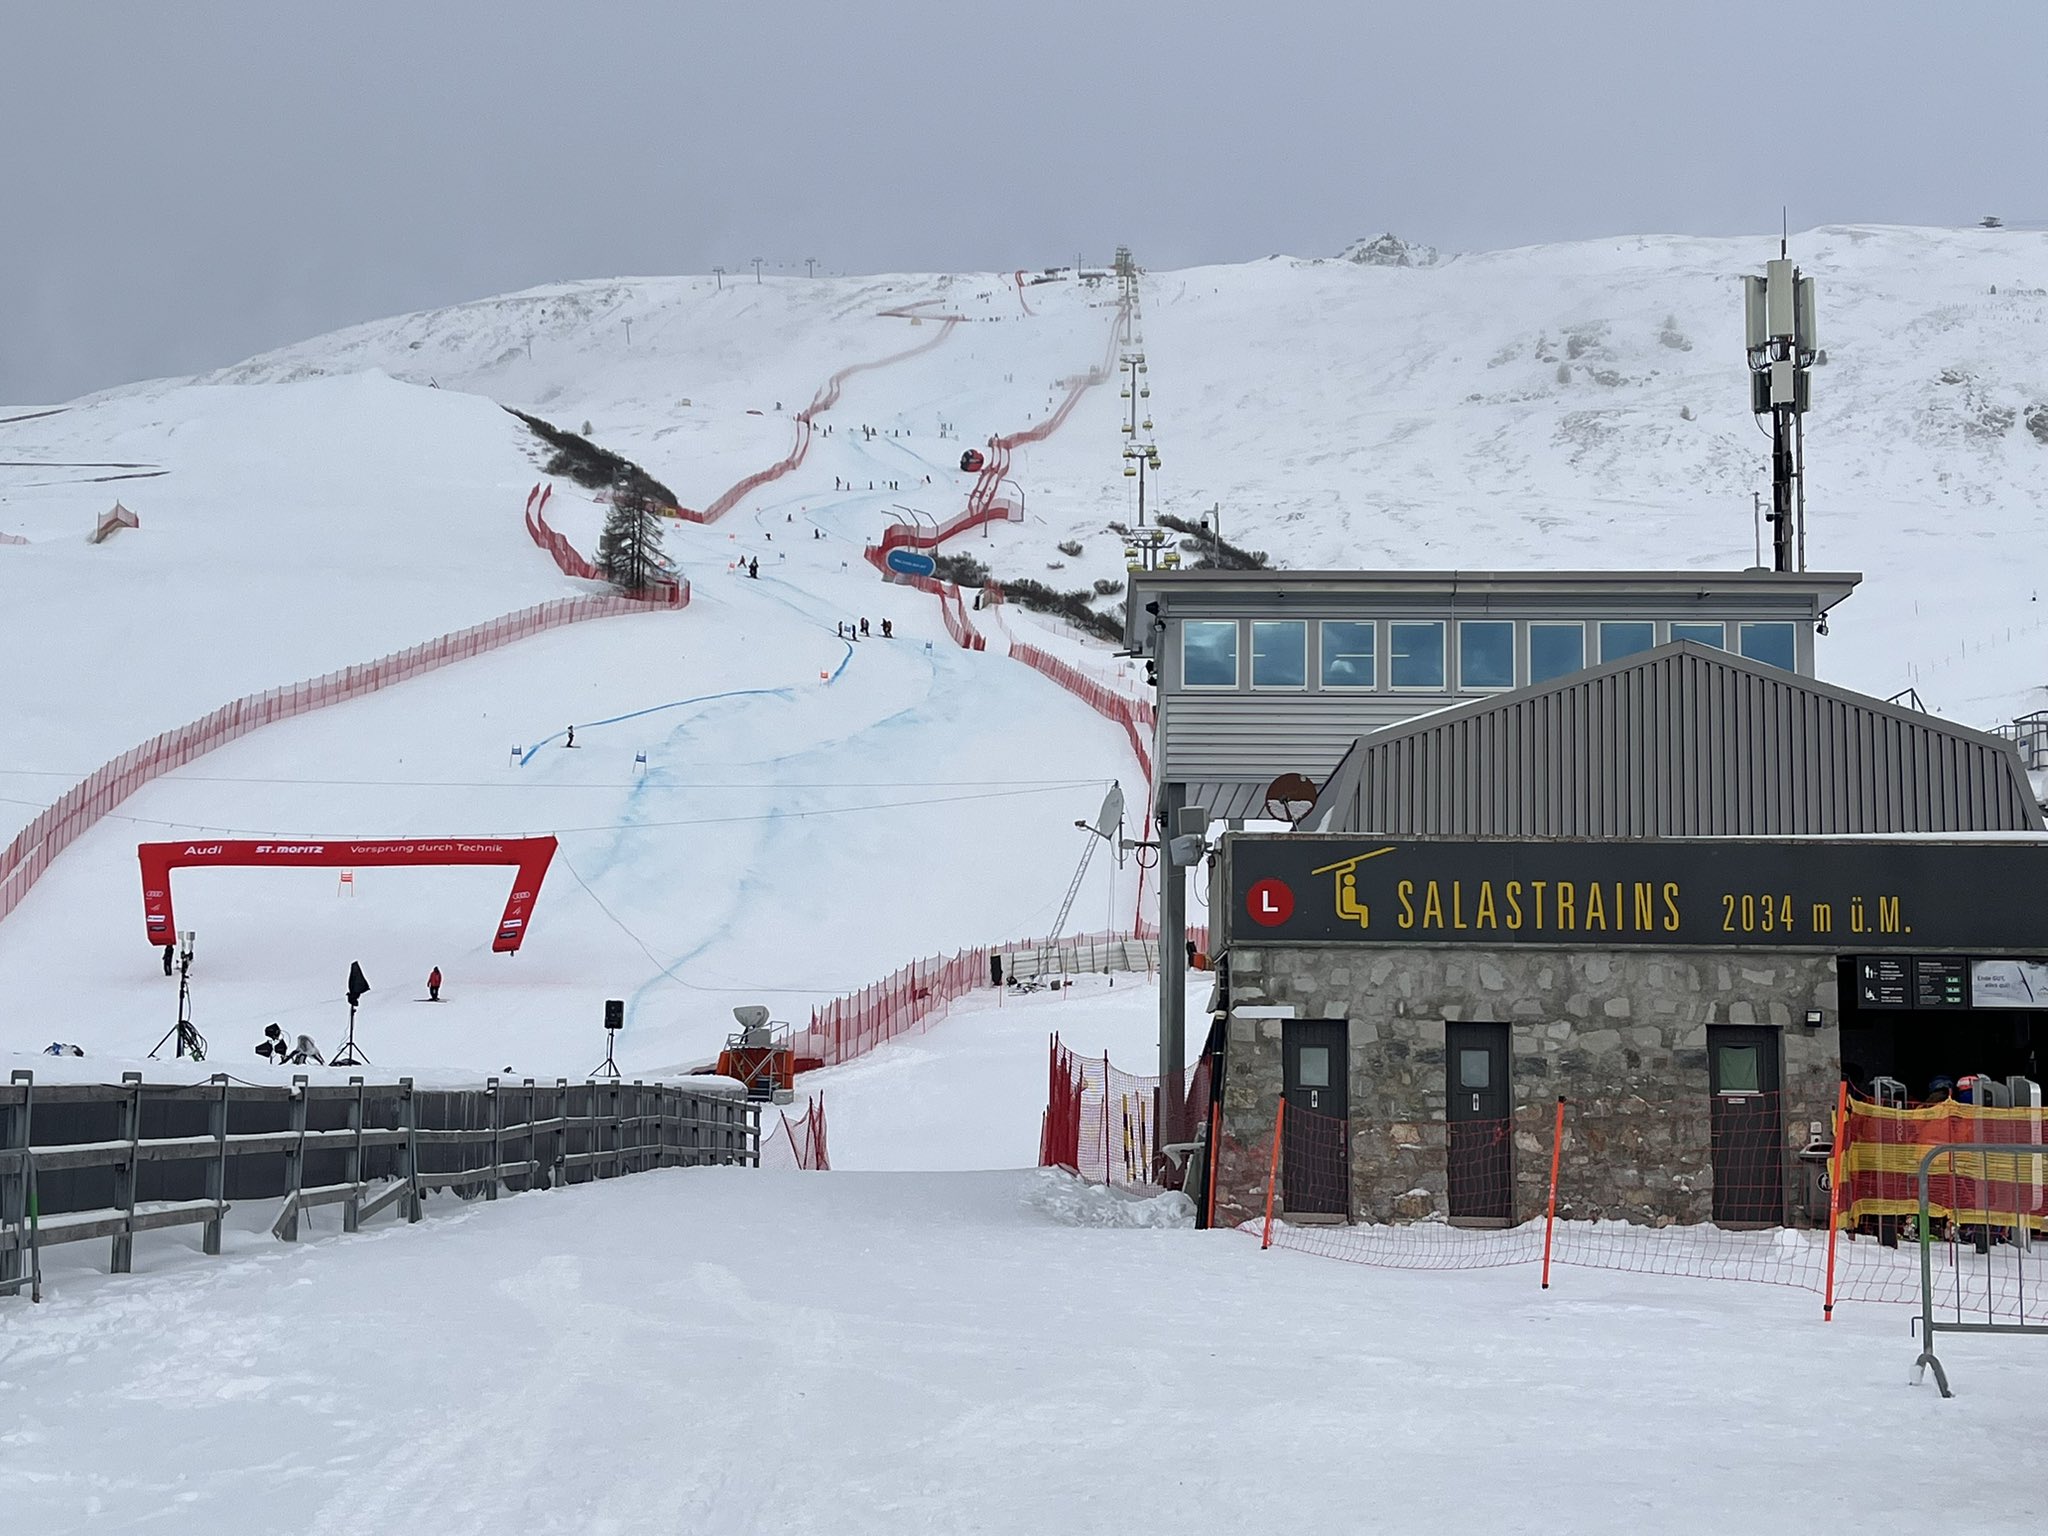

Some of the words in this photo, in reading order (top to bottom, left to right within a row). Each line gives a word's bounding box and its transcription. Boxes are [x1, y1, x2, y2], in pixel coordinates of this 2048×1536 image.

[184, 845, 223, 856] Audi
[350, 844, 414, 854] Vorsprung
[417, 843, 453, 852] durch
[456, 843, 503, 853] Technik
[1262, 890, 1278, 912] L
[1397, 880, 1680, 932] SALASTRAINS
[1722, 894, 1794, 932] 2034
[1812, 903, 1832, 932] m
